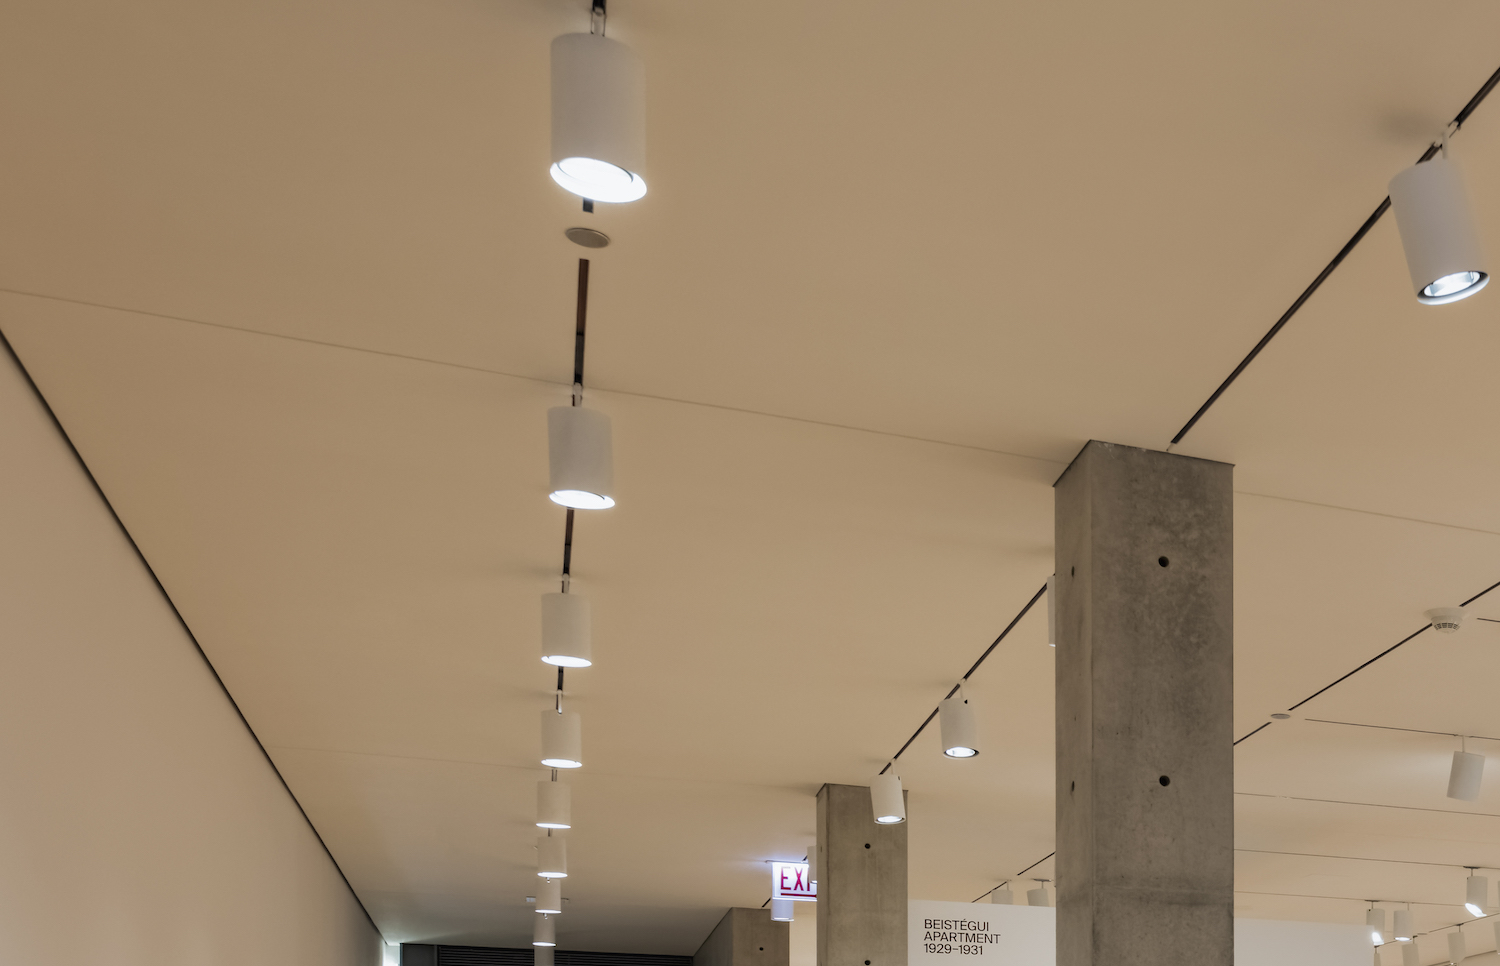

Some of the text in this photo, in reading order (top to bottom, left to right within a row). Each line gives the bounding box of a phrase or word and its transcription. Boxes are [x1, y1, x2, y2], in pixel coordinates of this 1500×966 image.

[780, 866, 810, 892] EXI
[924, 918, 989, 932] BEISTÉGUI
[923, 931, 1001, 944] APARTMENT
